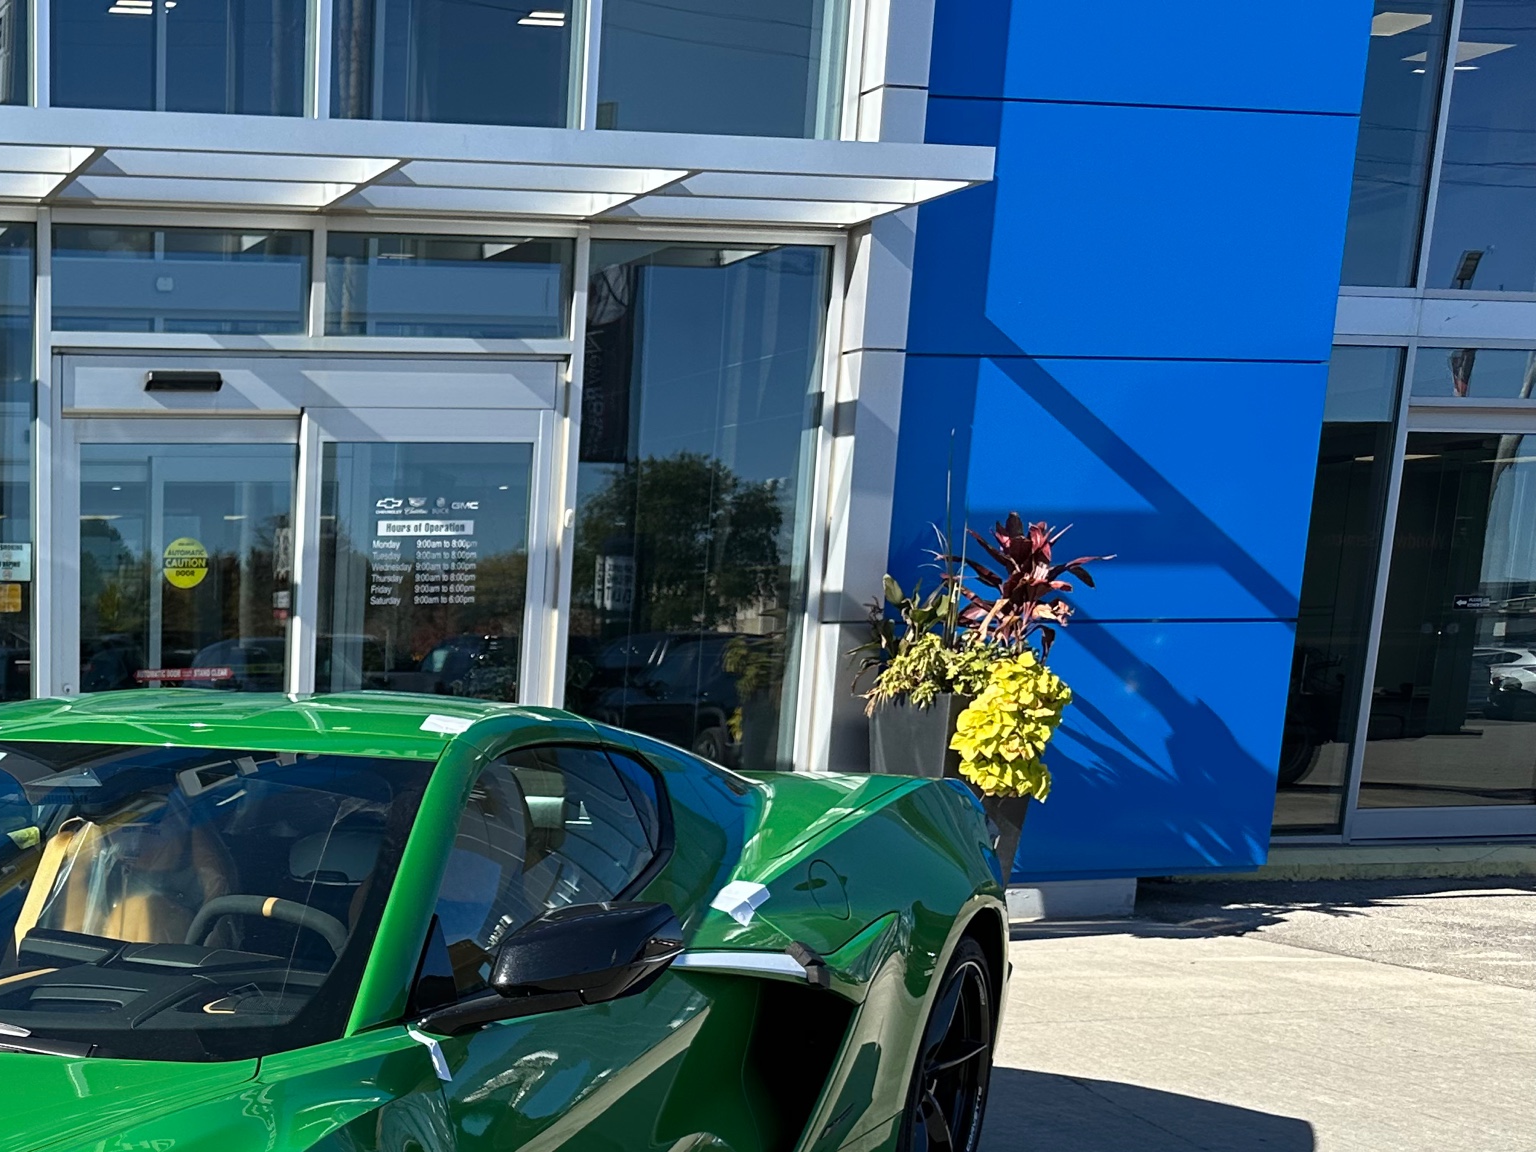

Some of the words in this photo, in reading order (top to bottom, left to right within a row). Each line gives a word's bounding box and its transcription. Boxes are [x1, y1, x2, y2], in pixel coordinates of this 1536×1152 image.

[451, 501, 479, 510] GMC
[385, 523, 411, 533] Hours
[413, 523, 422, 532] of
[424, 523, 465, 534] Operation
[372, 539, 401, 550] Monday
[416, 539, 442, 549] 9:00am
[443, 539, 450, 549] to
[451, 539, 478, 550] 8:00pm
[372, 551, 401, 561] Tuesday
[415, 551, 442, 560] 9:00am
[442, 551, 450, 560] to
[165, 558, 206, 568] CAUTION
[371, 563, 413, 573] Wednesday
[415, 562, 441, 571] 9:00am
[442, 562, 449, 571] to
[371, 574, 404, 584] Thursday
[414, 573, 441, 582] 9:00am
[441, 573, 449, 582] to
[370, 585, 393, 595] Friday
[414, 584, 440, 593] 9:00am
[441, 584, 448, 593] to
[370, 596, 401, 607] Saturday
[413, 595, 440, 605] 9:00am
[440, 595, 448, 604] to
